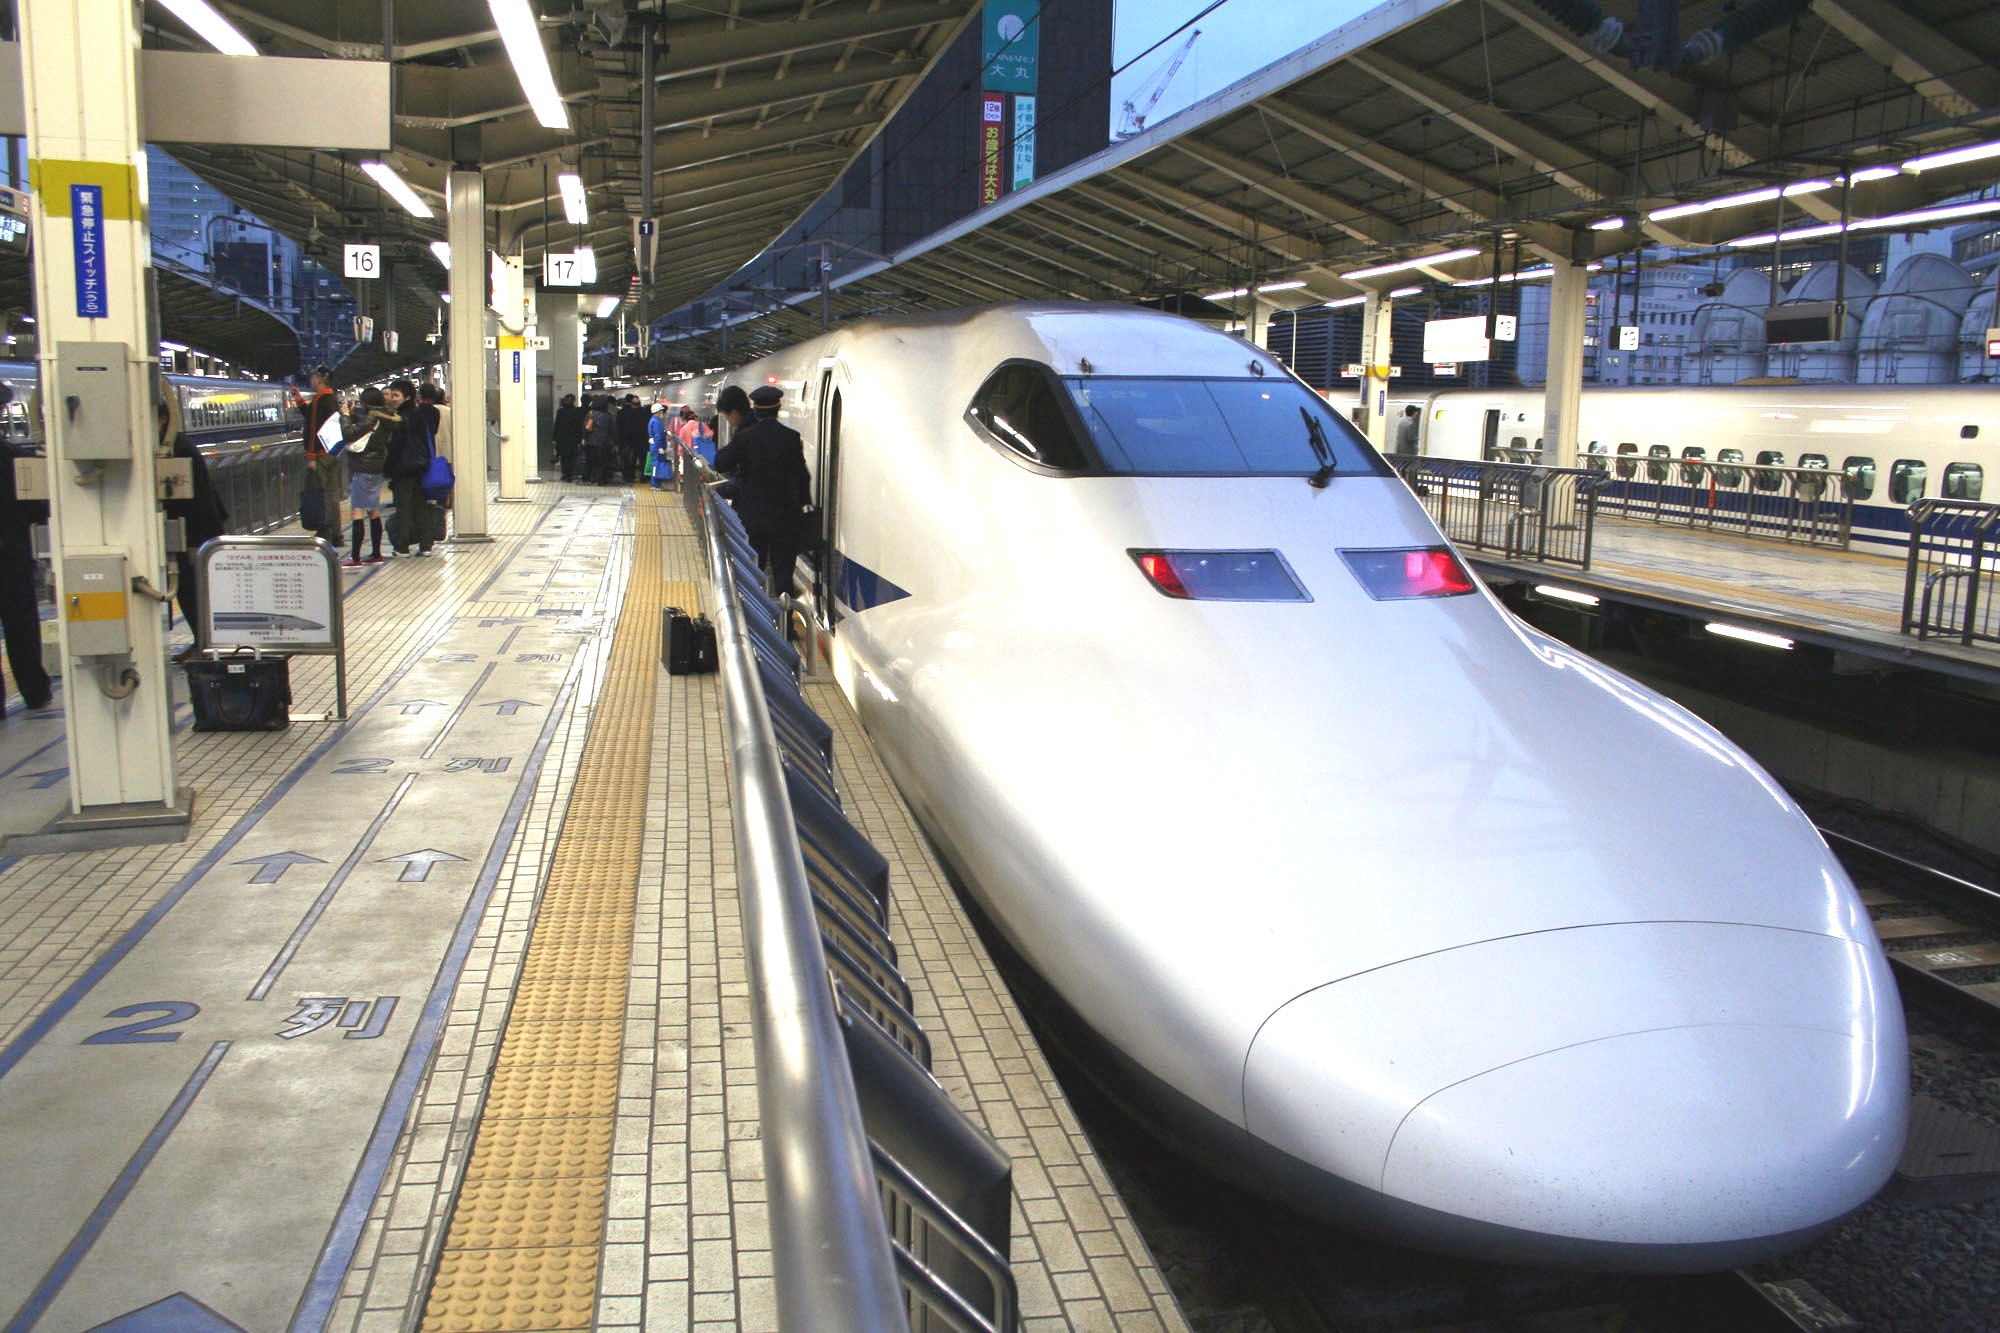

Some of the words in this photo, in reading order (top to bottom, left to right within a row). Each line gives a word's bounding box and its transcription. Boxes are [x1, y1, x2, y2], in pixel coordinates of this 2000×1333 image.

[351, 251, 374, 272] 16
[554, 260, 575, 279] 17
[330, 757, 394, 774] 2
[442, 756, 513, 774] 列
[80, 1000, 201, 1045] 2
[274, 996, 401, 1040] 列
